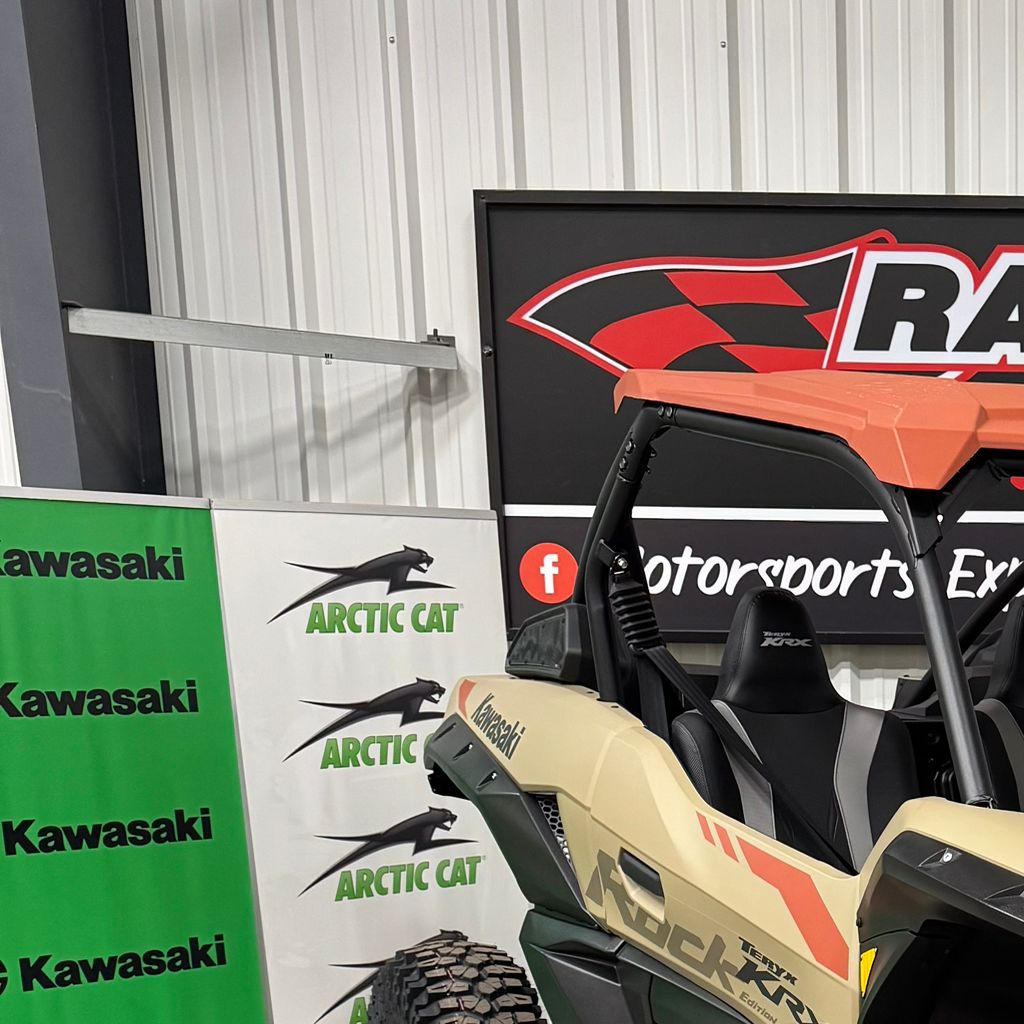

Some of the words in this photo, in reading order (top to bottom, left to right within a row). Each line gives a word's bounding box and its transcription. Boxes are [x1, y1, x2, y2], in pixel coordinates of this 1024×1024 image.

[0, 545, 185, 581] awasaki
[638, 545, 915, 600] otorsports
[305, 602, 405, 634] ARCTIC
[410, 602, 459, 633] CAT
[760, 637, 813, 647] KRX
[0, 679, 199, 718] Kawasaki
[470, 692, 526, 761] Kawasaki
[320, 733, 418, 770] ARCTIC
[3, 807, 213, 856] Kawasaki
[334, 861, 430, 902] ARCTIC
[435, 855, 482, 888] CAT
[19, 933, 228, 993] Kawasaki
